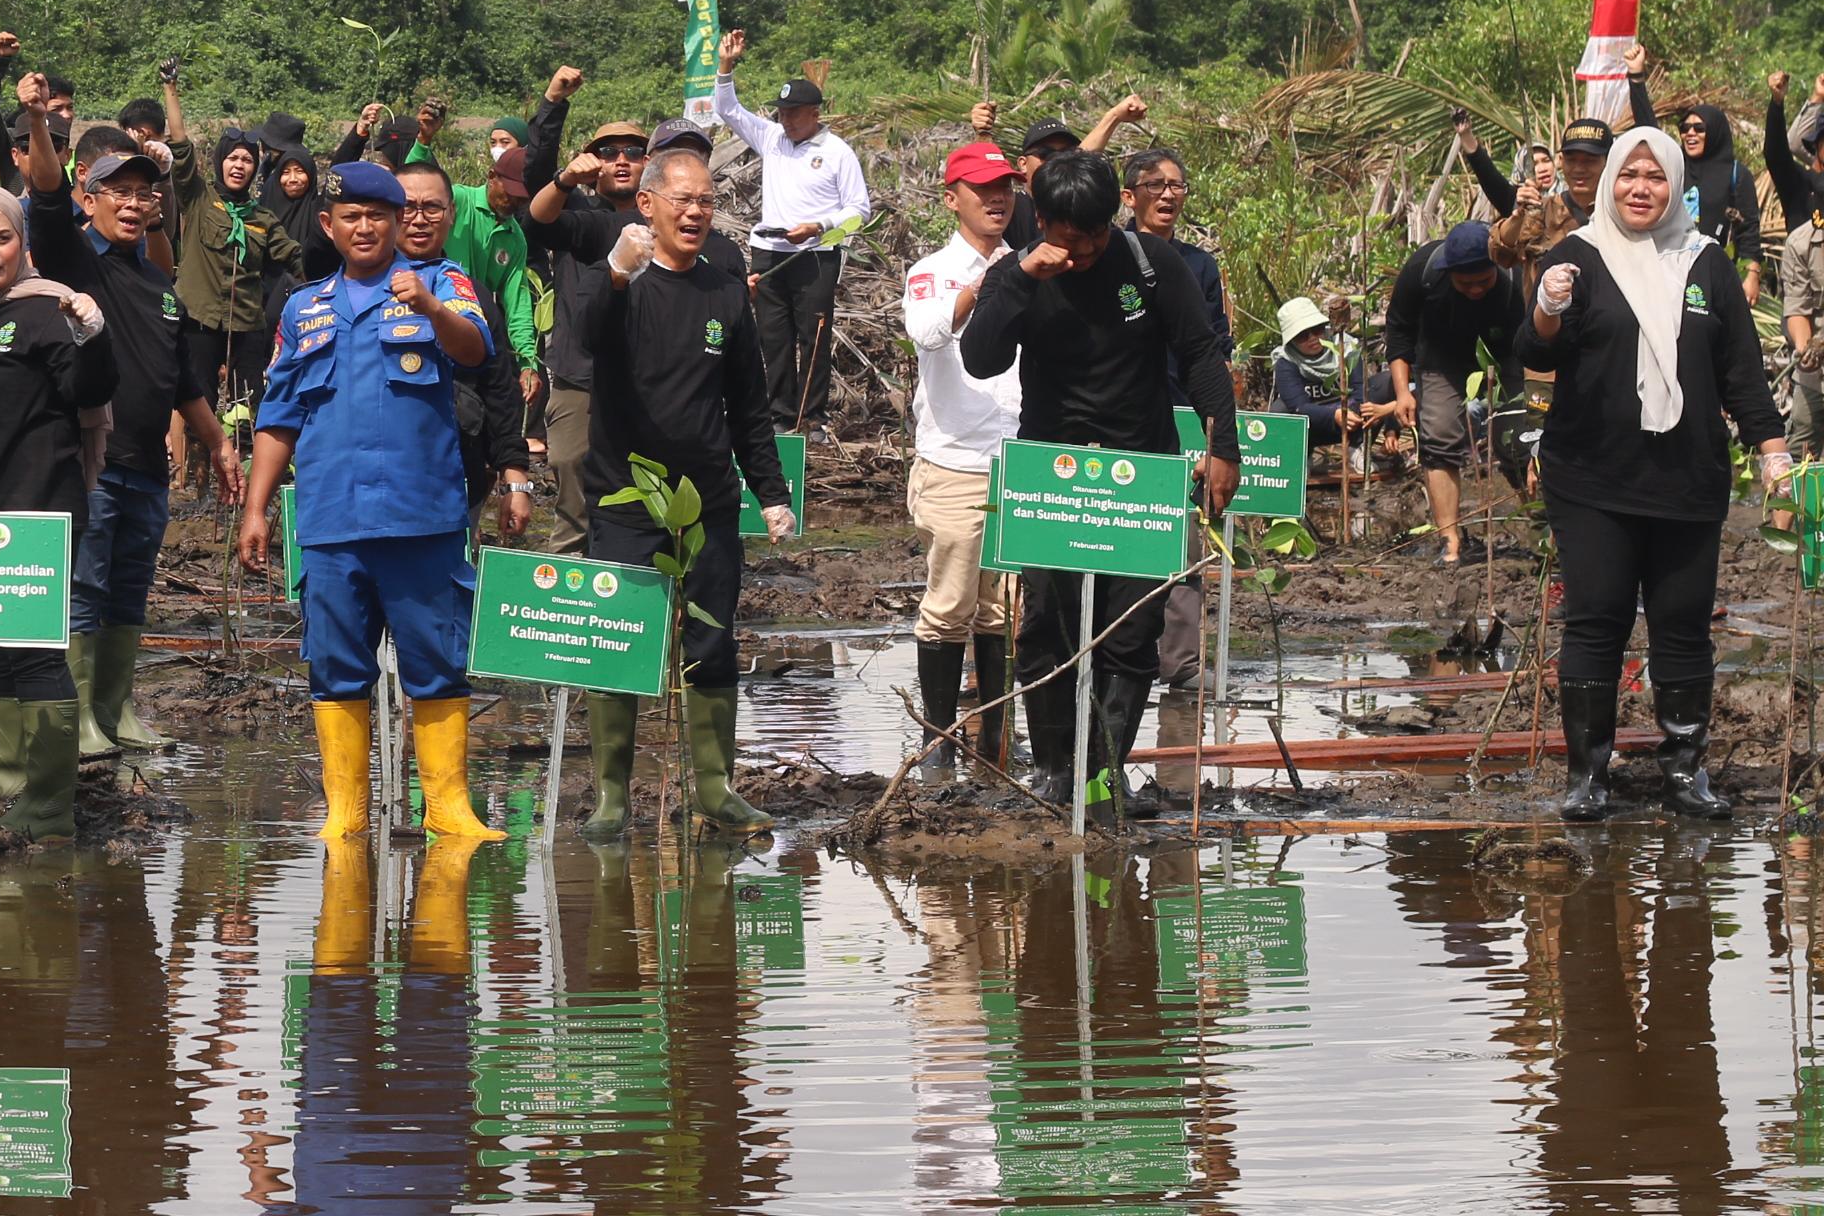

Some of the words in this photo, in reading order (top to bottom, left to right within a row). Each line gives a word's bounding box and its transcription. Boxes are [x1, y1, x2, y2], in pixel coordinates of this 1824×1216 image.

[384, 306, 415, 320] POL
[297, 313, 334, 333] TAUFIK
[1185, 450, 1206, 462] KK
[1252, 474, 1289, 488] Timur
[1073, 486, 1097, 494] Ditanam
[1004, 489, 1041, 502] Deputi
[1044, 493, 1081, 508] Bidang
[1085, 497, 1147, 513] Lingkungan
[1150, 504, 1183, 518] Hidup
[1013, 507, 1034, 518] dan
[1037, 509, 1080, 522] Sumber
[1083, 514, 1110, 528] Daya
[1113, 517, 1140, 528] Alam
[1143, 520, 1172, 532] OIKN
[1074, 542, 1098, 550] Februari
[552, 596, 577, 606] Ditanam
[500, 604, 517, 617] PJ
[521, 606, 586, 626] Gubernur
[589, 615, 644, 634] Provinsi
[510, 625, 586, 646] Kalimantan
[591, 636, 630, 652] Timur
[549, 654, 575, 663] Februari
